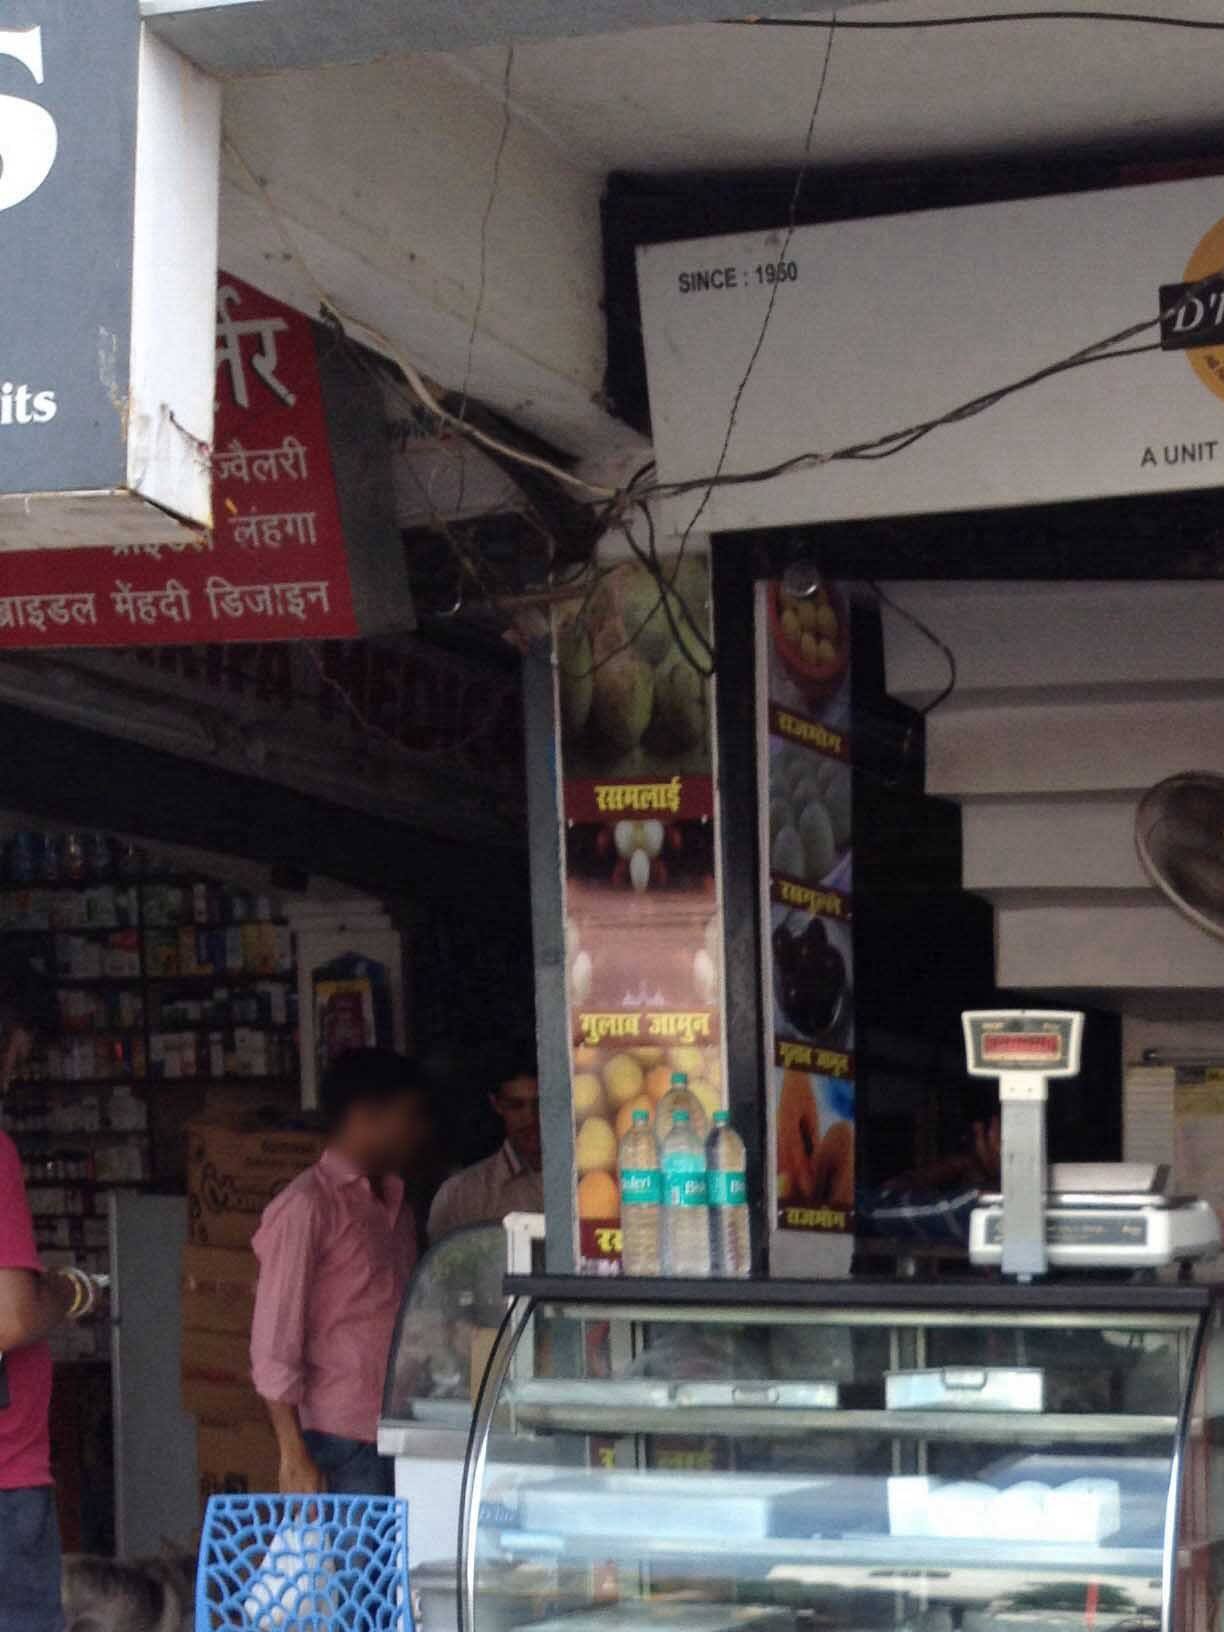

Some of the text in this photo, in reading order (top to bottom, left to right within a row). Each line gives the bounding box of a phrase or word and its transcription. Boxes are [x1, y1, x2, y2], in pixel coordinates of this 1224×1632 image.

[679, 267, 737, 293] SINCE
[1141, 449, 1157, 467] A
[1164, 441, 1218, 465] UNIT
[579, 1011, 711, 1045] गुलाब जामुन
